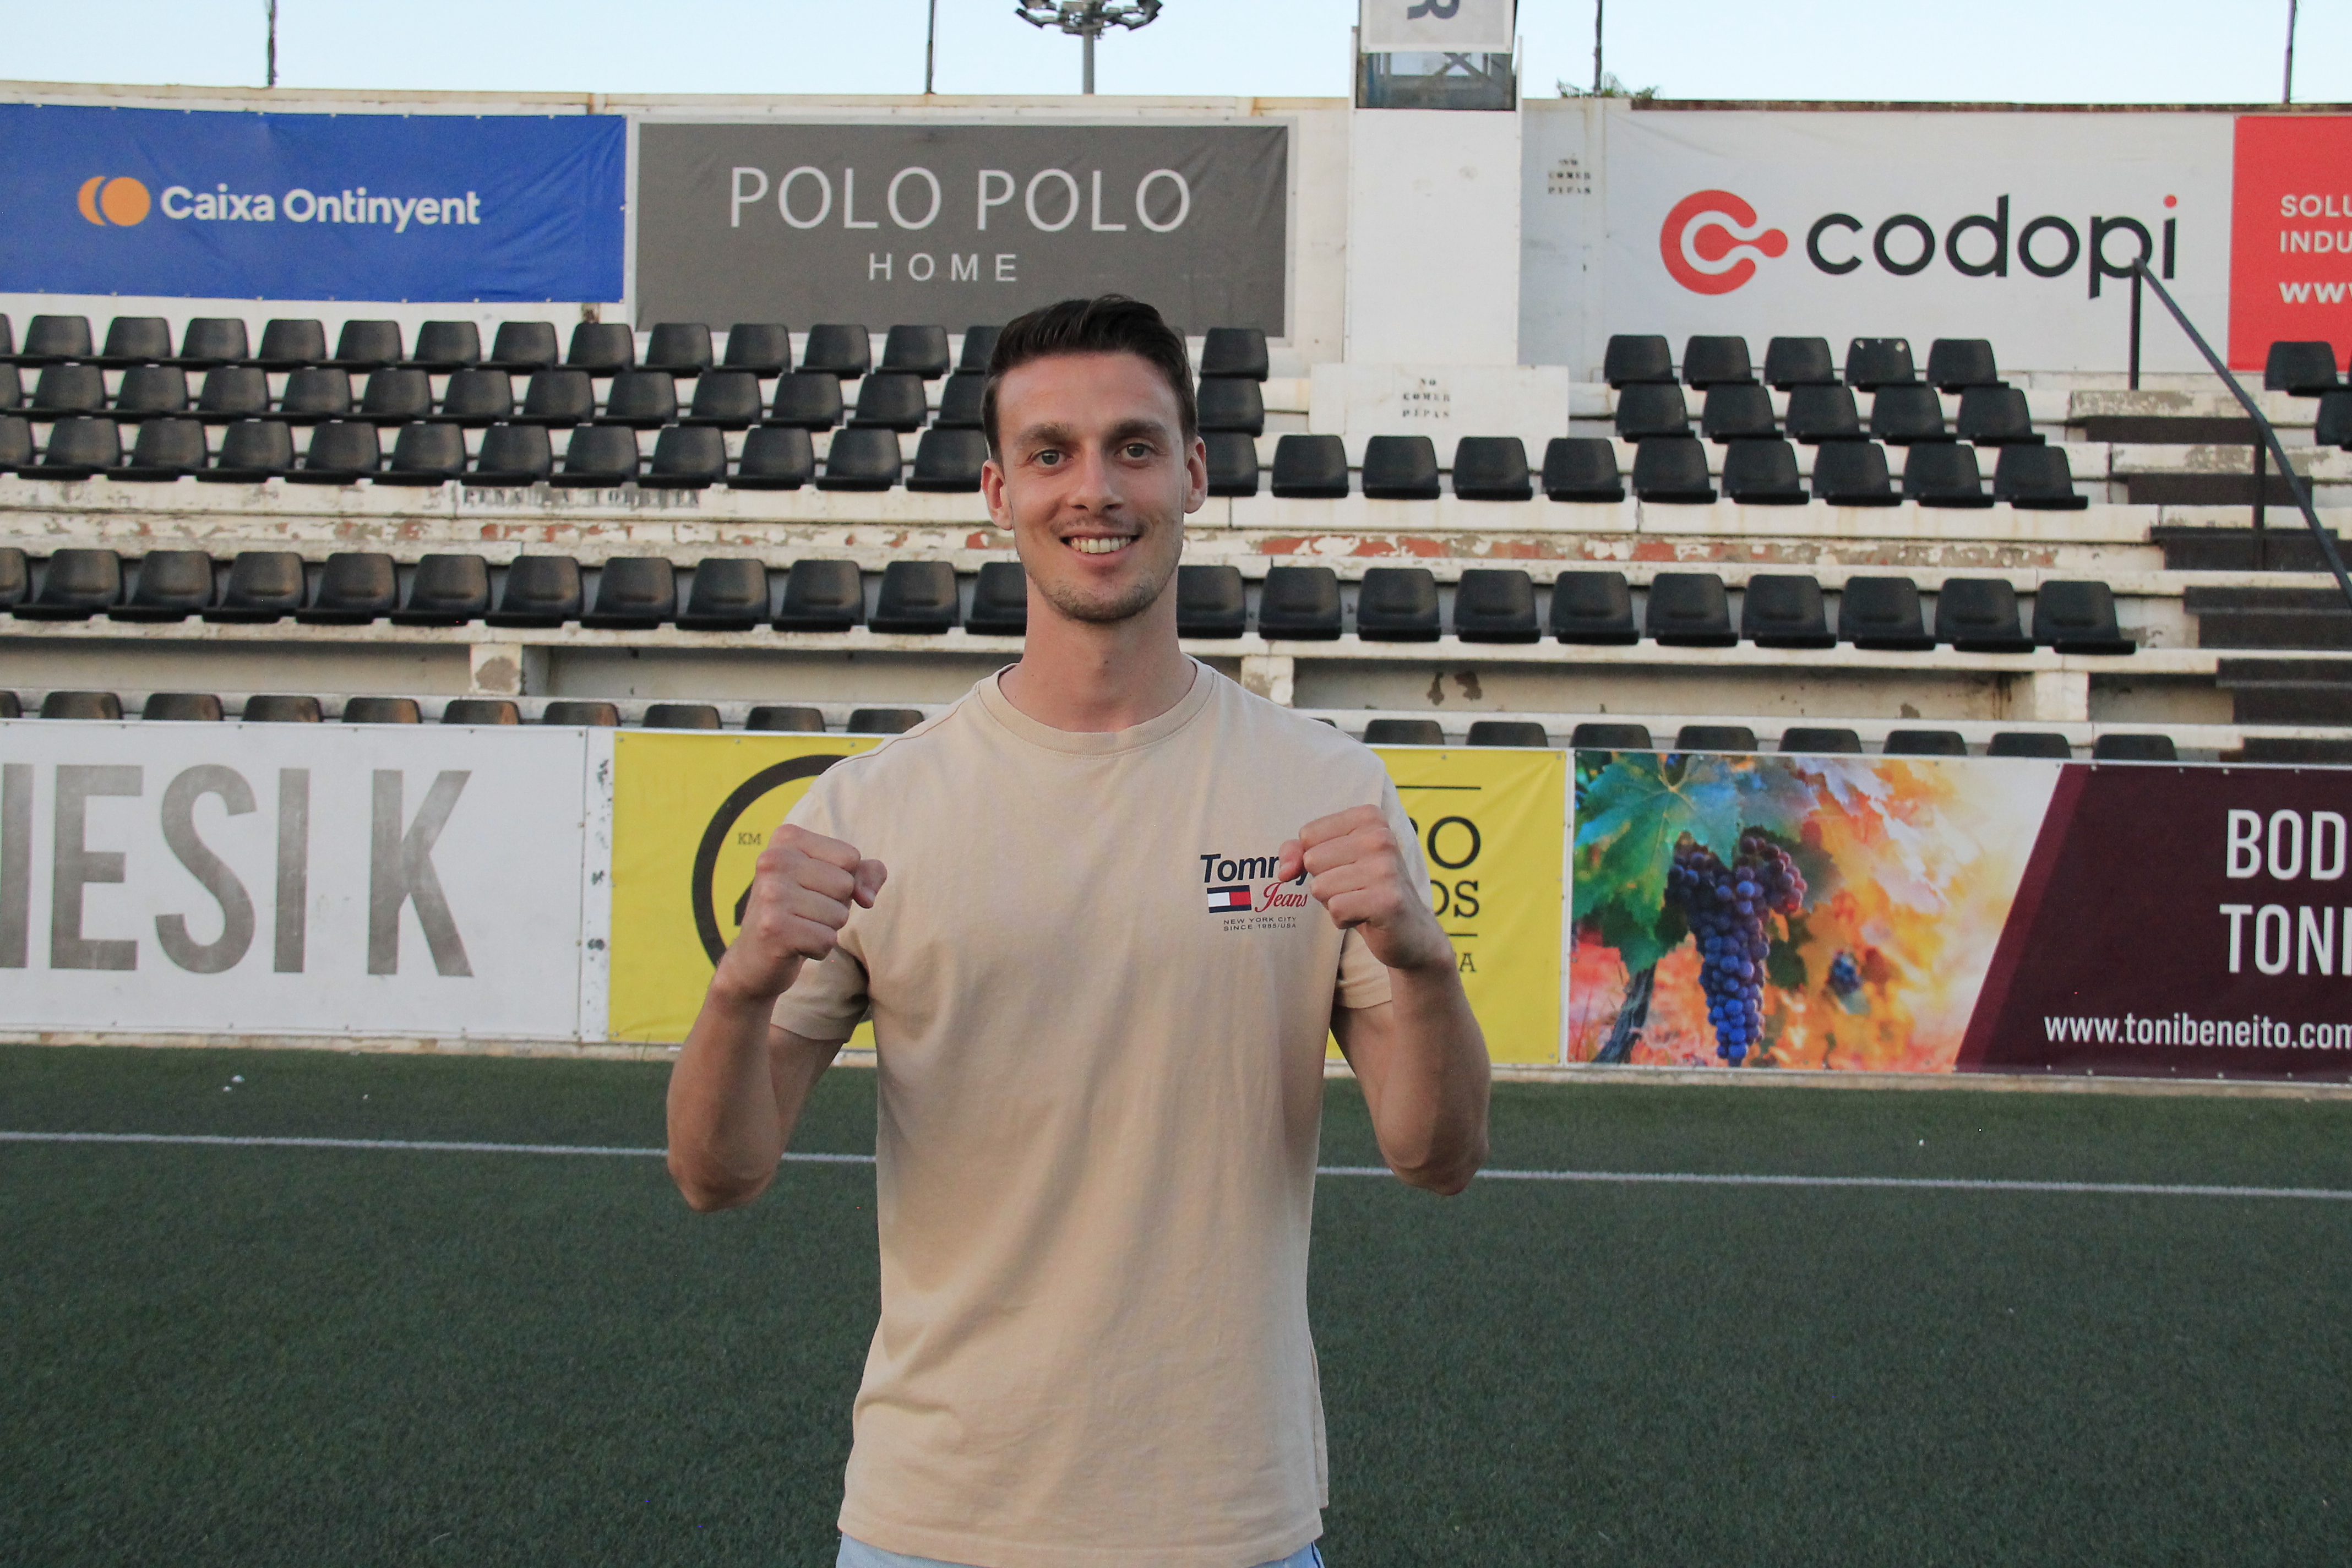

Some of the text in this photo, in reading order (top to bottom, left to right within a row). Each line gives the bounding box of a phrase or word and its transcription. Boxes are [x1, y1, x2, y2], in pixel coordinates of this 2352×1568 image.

[160, 183, 481, 234] Caixa Ontinyent
[730, 165, 1191, 233] POLO POLO
[868, 252, 1017, 282] HOME
[1806, 193, 2177, 300] codopi
[2226, 808, 2348, 881] BOD
[1254, 881, 1308, 913] Jeans
[2044, 1012, 2352, 1050] www.tonibeneito.com
